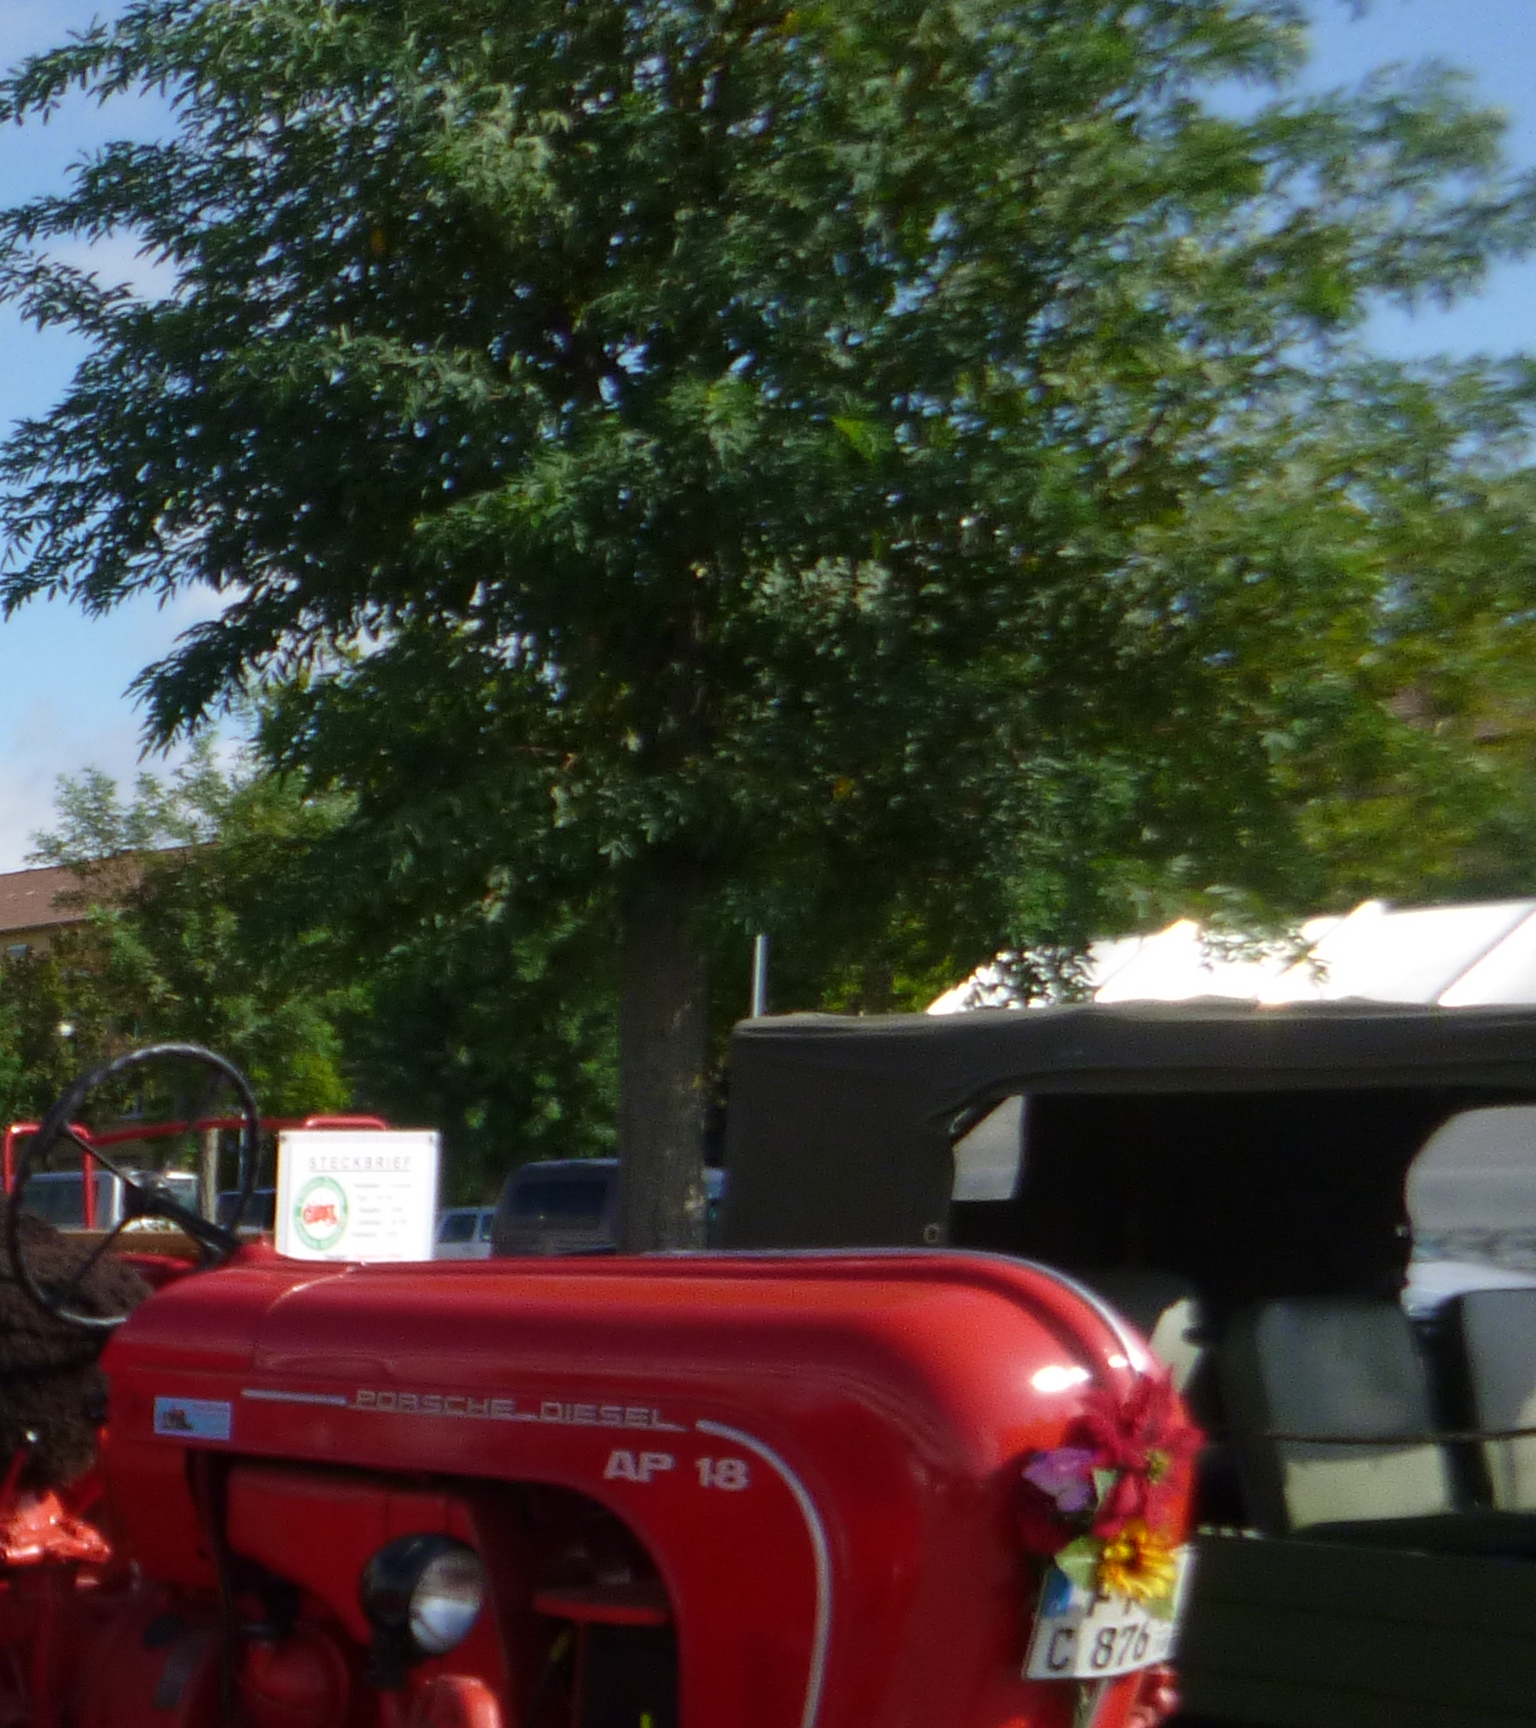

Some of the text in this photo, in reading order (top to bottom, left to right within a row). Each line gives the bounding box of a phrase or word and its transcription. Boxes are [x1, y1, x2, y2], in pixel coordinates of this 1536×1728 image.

[308, 1156, 412, 1171] STECKBRIEF
[355, 1389, 670, 1429] PORSCHE DIESEL
[602, 1448, 750, 1492] AP 18
